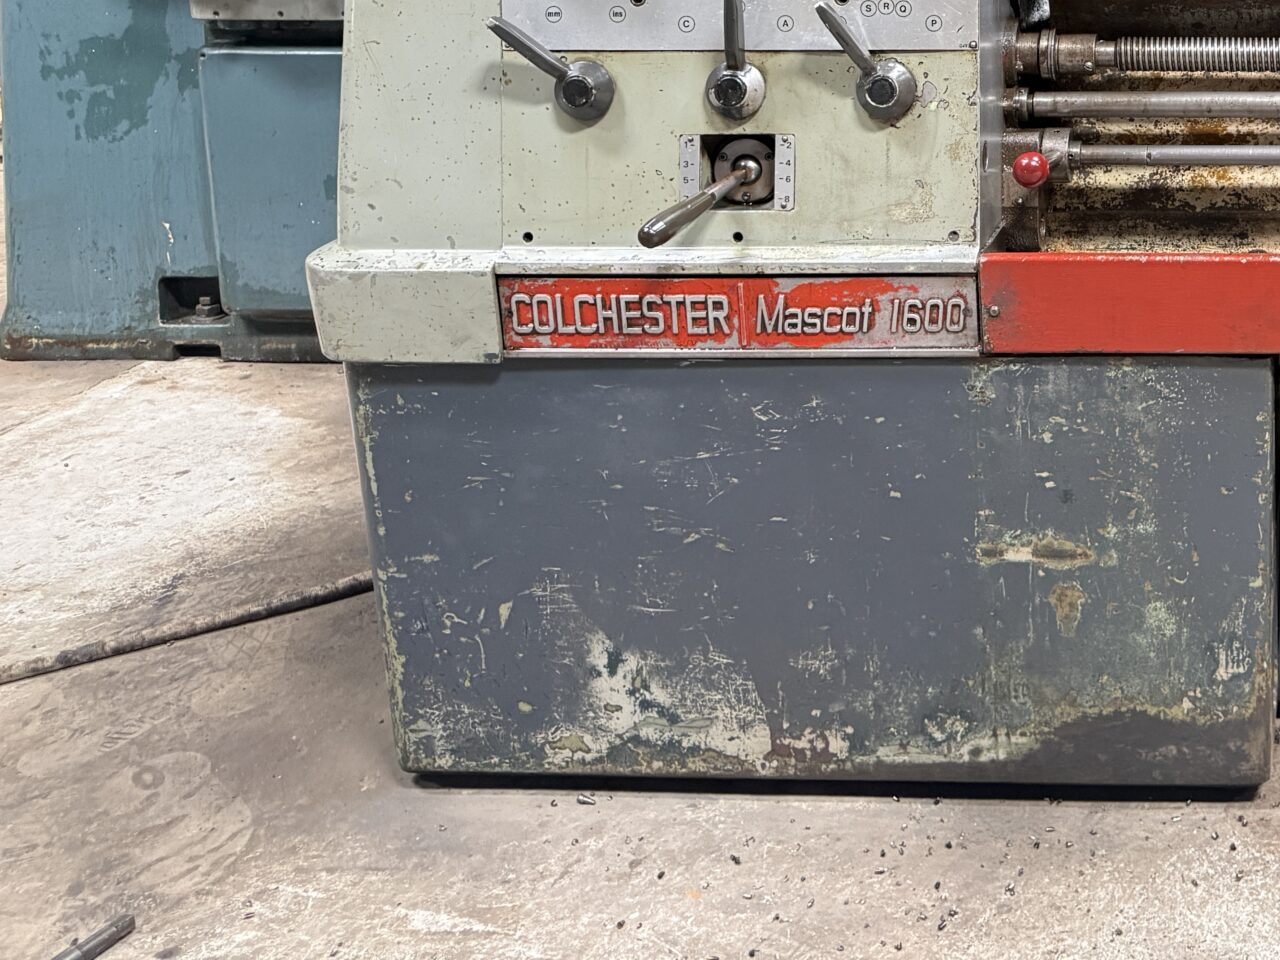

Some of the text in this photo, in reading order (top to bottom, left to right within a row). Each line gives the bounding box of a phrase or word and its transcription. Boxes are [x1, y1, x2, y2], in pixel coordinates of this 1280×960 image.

[900, 5, 907, 13] Q
[612, 10, 623, 18] ins
[683, 20, 690, 28] C
[683, 160, 689, 168] 3
[511, 293, 965, 335] COLCHESTER Mascot 1600
